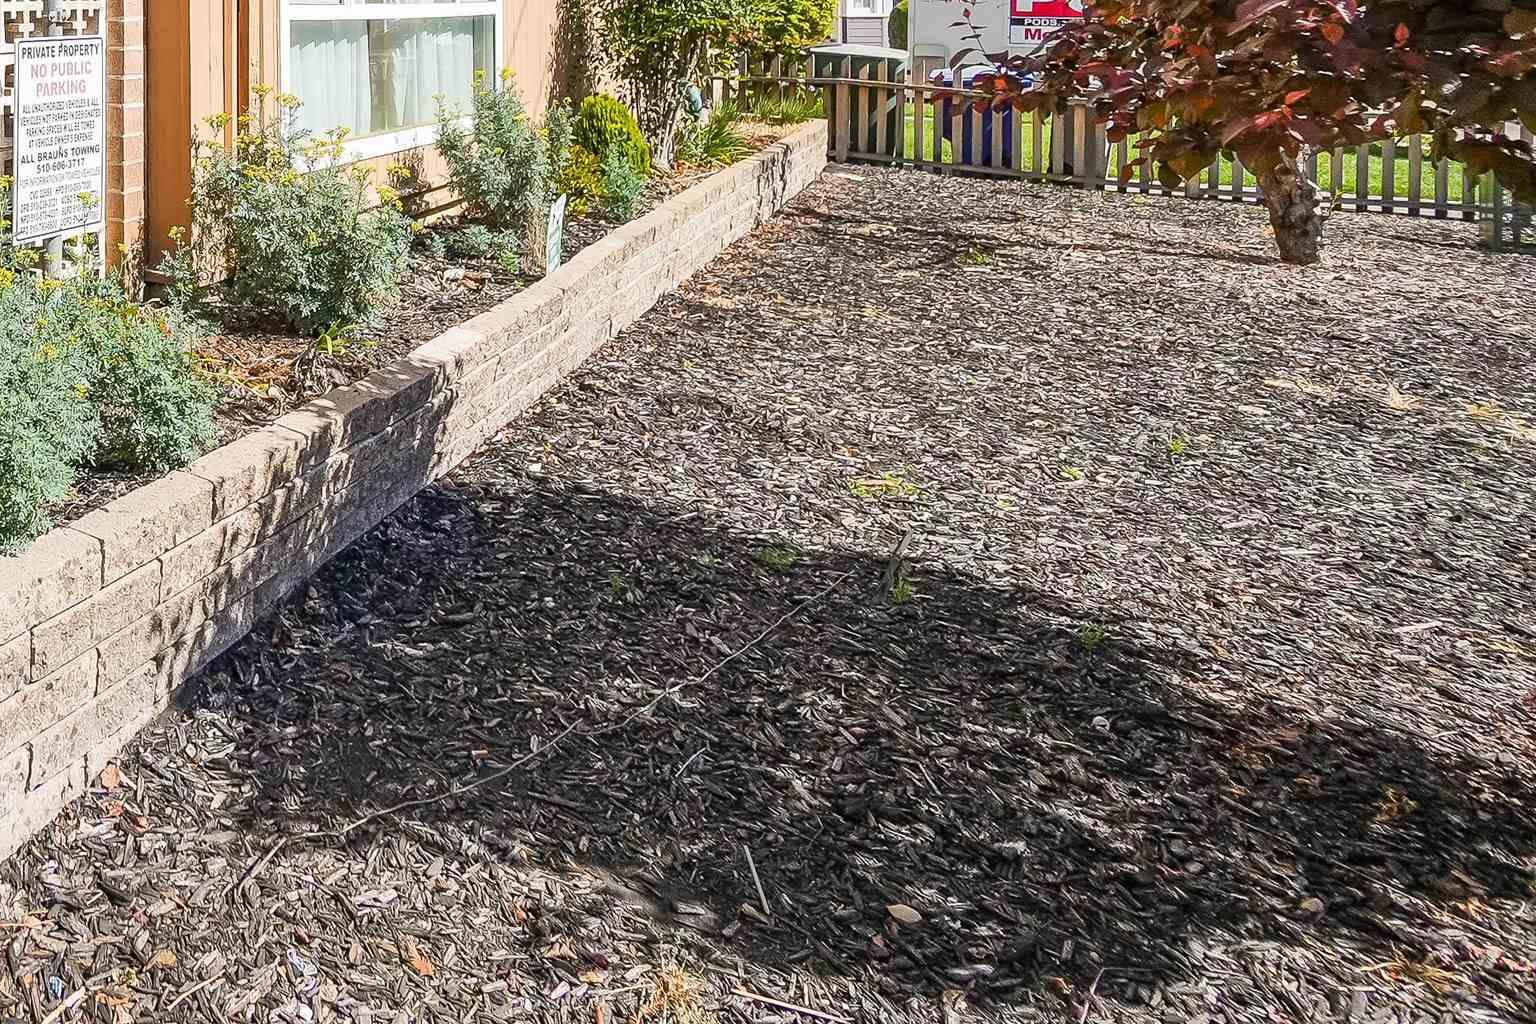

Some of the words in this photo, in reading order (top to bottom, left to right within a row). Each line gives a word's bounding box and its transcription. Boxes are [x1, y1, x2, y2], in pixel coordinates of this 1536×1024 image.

[21, 45, 56, 59] PRIVATE
[58, 43, 100, 57] PROPERTY
[30, 63, 47, 79] NO
[51, 61, 92, 77] PUBLIC
[36, 79, 87, 97] PARKING
[21, 153, 34, 164] ALL
[37, 148, 68, 162] BRAUNS
[71, 144, 100, 158] TOWING
[36, 158, 85, 174] 510-606-3717
